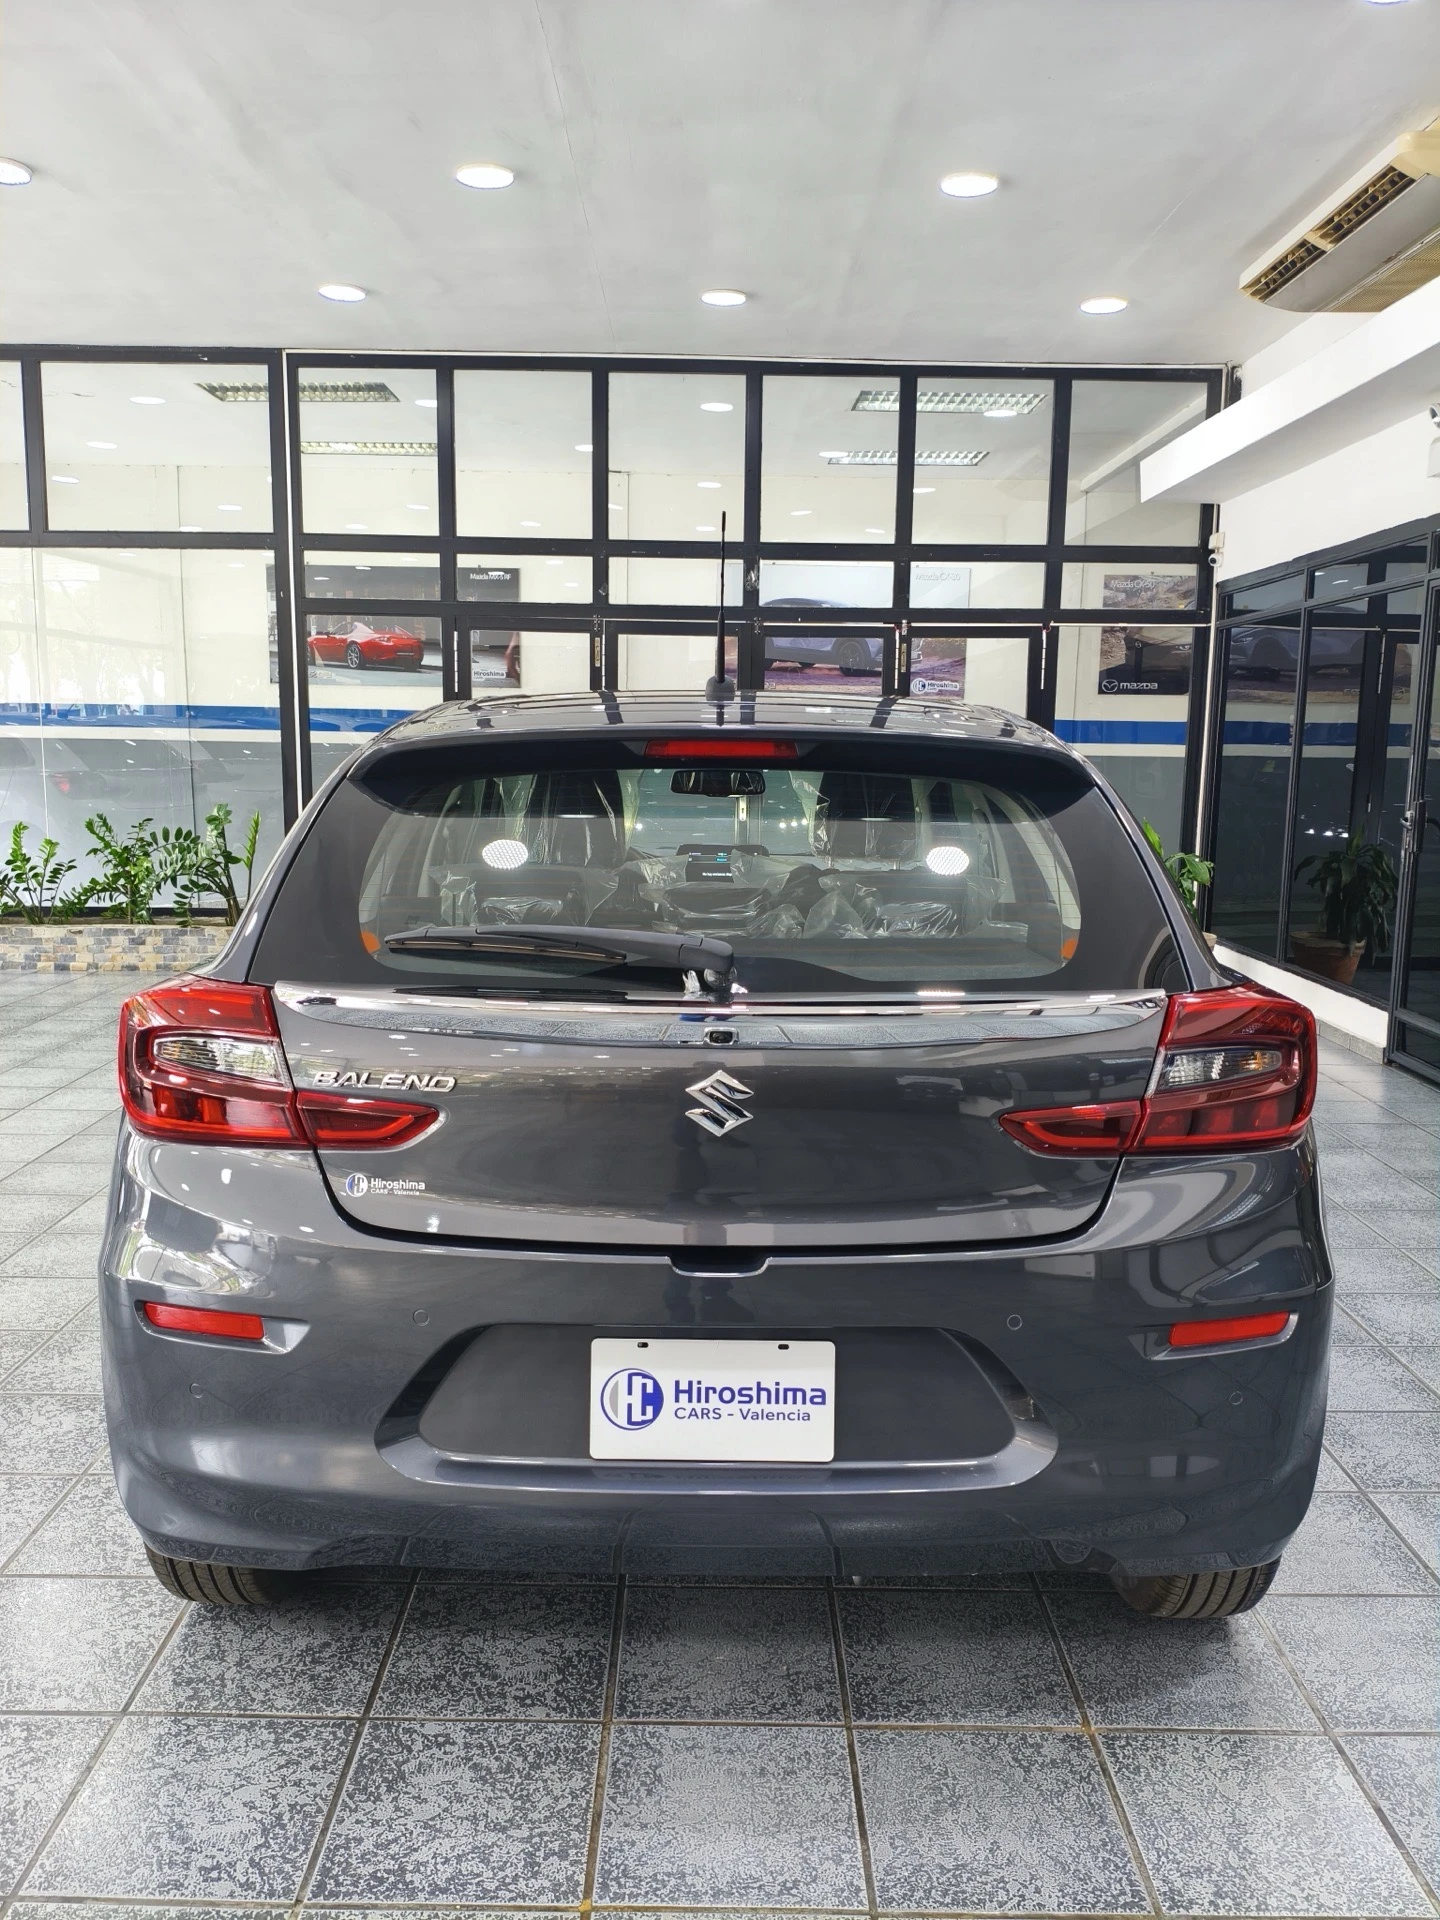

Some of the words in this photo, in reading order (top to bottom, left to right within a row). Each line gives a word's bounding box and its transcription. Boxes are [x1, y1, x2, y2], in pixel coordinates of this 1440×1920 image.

[313, 1071, 456, 1092] BALENO
[370, 1178, 426, 1190] Hiroshima
[674, 1380, 827, 1406] Hiroshima
[674, 1407, 722, 1420] CARS
[739, 1408, 811, 1421] Valencia
